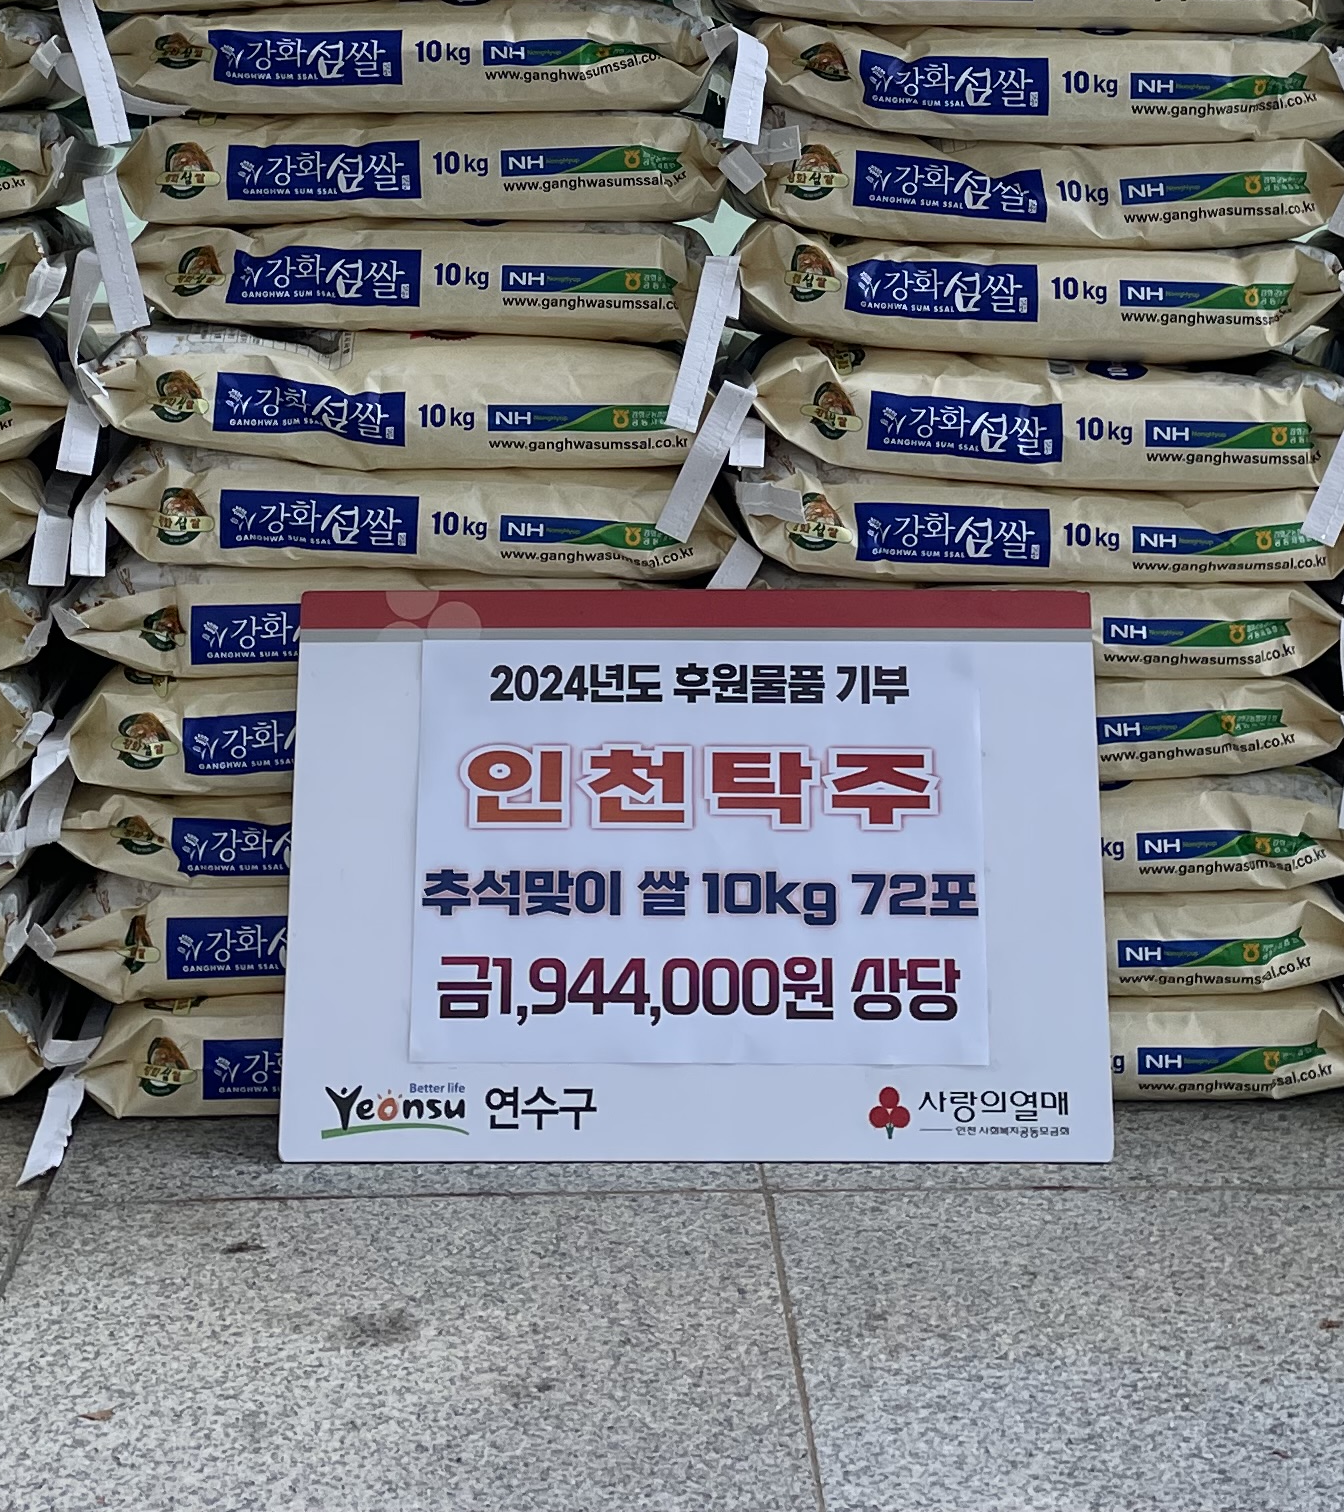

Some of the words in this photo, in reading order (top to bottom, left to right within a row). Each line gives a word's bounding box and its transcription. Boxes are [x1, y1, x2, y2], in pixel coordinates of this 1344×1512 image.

[871, 94, 918, 104] GANGHWA
[922, 99, 940, 107] SUM
[944, 99, 964, 107] SSAL
[897, 63, 1036, 107] 강화섬쌀
[1138, 79, 1174, 94] NH
[243, 187, 290, 195] GANGHWA
[294, 187, 313, 195] SUM
[317, 187, 338, 195] SSAL
[265, 151, 407, 193] 강화섬쌀
[508, 155, 544, 170] NH
[1127, 182, 1165, 199] NH
[1123, 198, 1315, 222] www.ganghwasumssal.co.kr
[860, 301, 907, 311] GANGHWA
[911, 304, 930, 312] SUM
[933, 305, 954, 313] SSAL
[883, 269, 1024, 313] 강화섬쌀
[1127, 286, 1164, 301] NH
[488, 435, 688, 453] www.ganghwasumssal.co.kr
[258, 500, 402, 545] 강화섬쌀
[507, 522, 544, 537] NH
[893, 512, 1035, 559] 강화섬쌀
[1140, 532, 1177, 548] NH
[1131, 555, 1327, 575] www.ganghwasumssal.co.kr
[490, 664, 663, 704] 2024년도
[674, 662, 826, 704] 후원물품
[836, 664, 910, 704] 기부
[462, 745, 936, 828] 인천탁주
[421, 868, 623, 917] 추석맞이
[637, 869, 692, 917] 쌀
[701, 870, 838, 927] 10kg
[850, 871, 981, 917] 72포
[436, 955, 835, 1027] 금1,944,000원
[850, 957, 962, 1022] 상당
[325, 1085, 466, 1131] Yeonsu
[409, 1082, 445, 1094] Better
[447, 1082, 466, 1094] life
[485, 1086, 598, 1131] 연수구
[918, 1090, 1069, 1123] 사랑의열매
[955, 1126, 977, 1136] 인천
